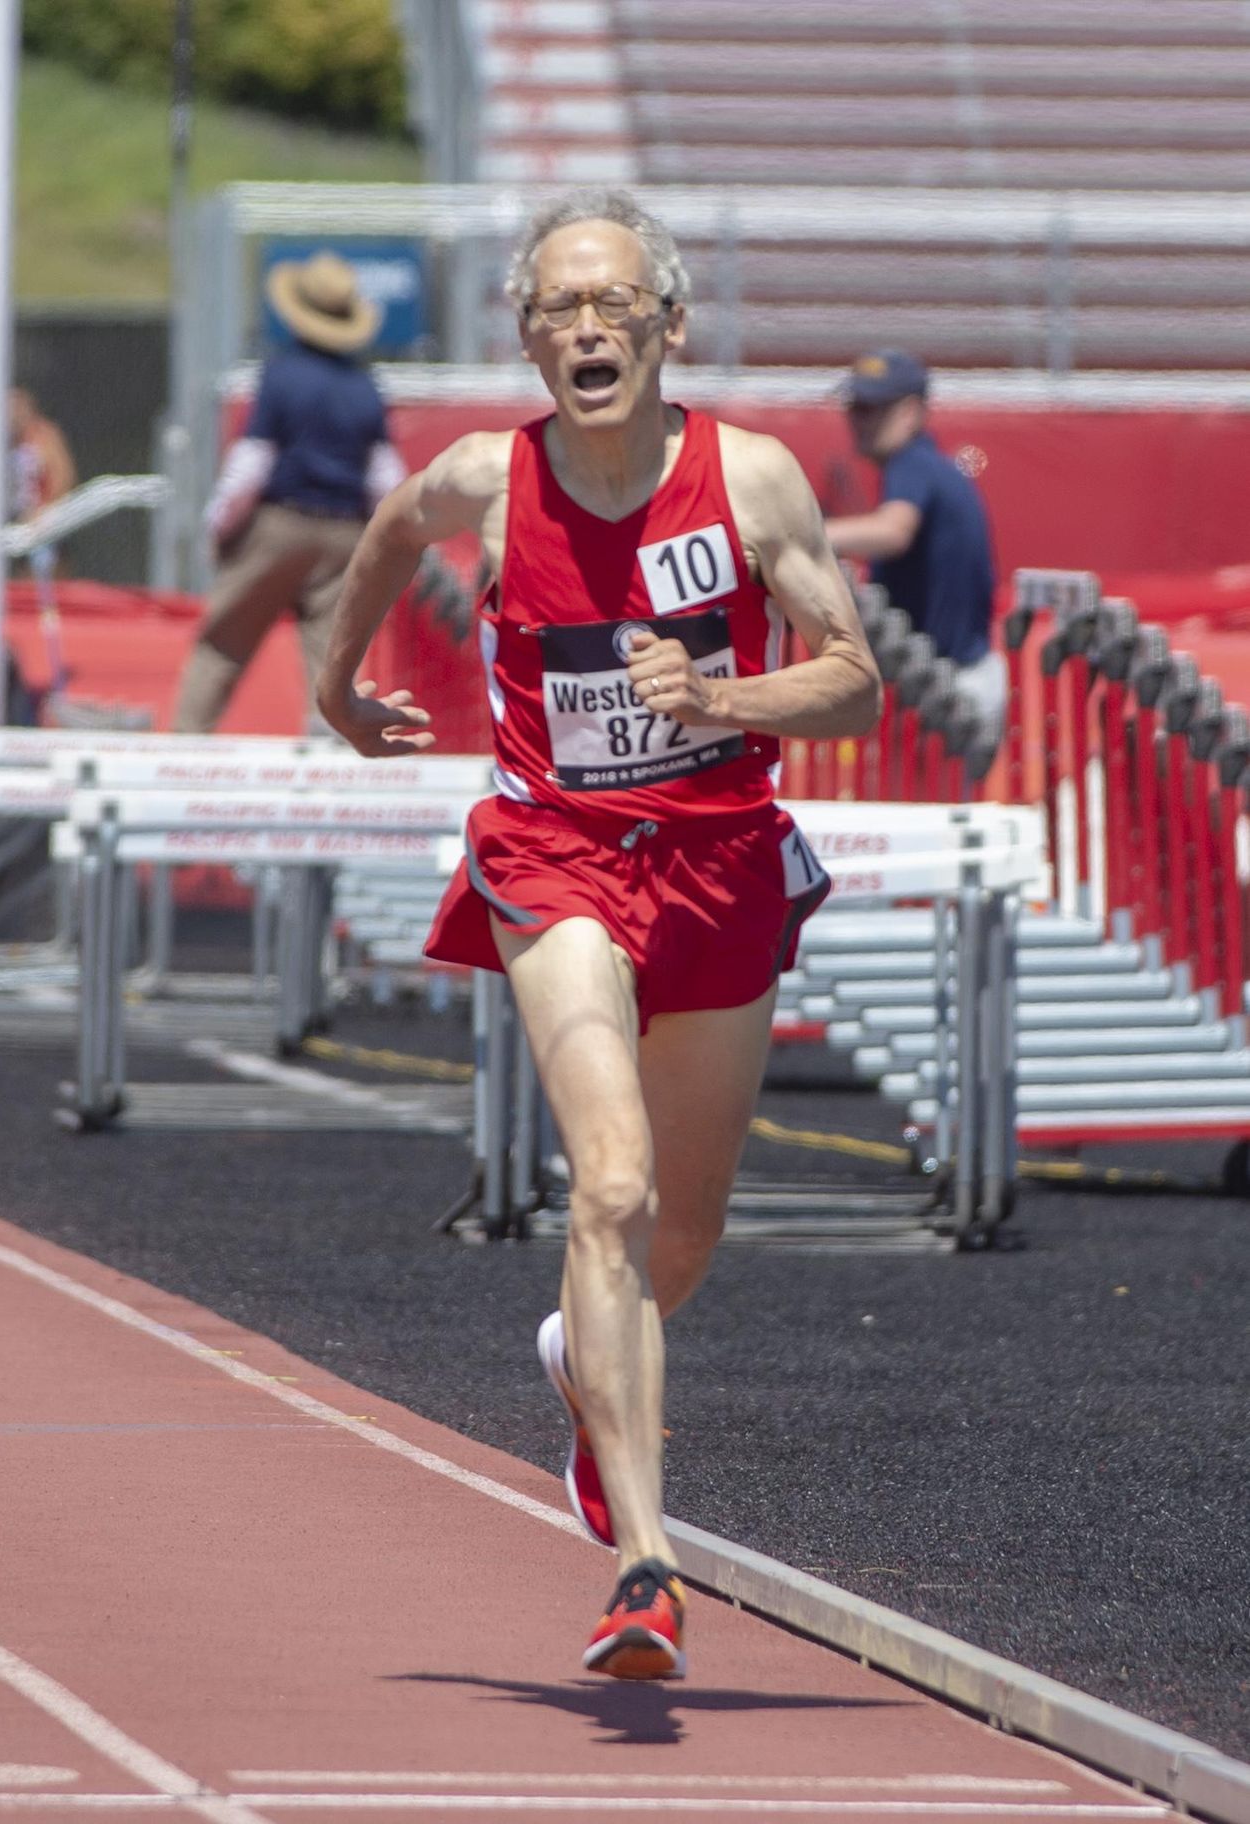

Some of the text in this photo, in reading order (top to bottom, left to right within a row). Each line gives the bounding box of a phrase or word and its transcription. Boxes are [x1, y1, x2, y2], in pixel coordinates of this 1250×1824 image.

[657, 534, 718, 602] 10
[552, 664, 729, 713] Westerg
[607, 711, 689, 757] 872
